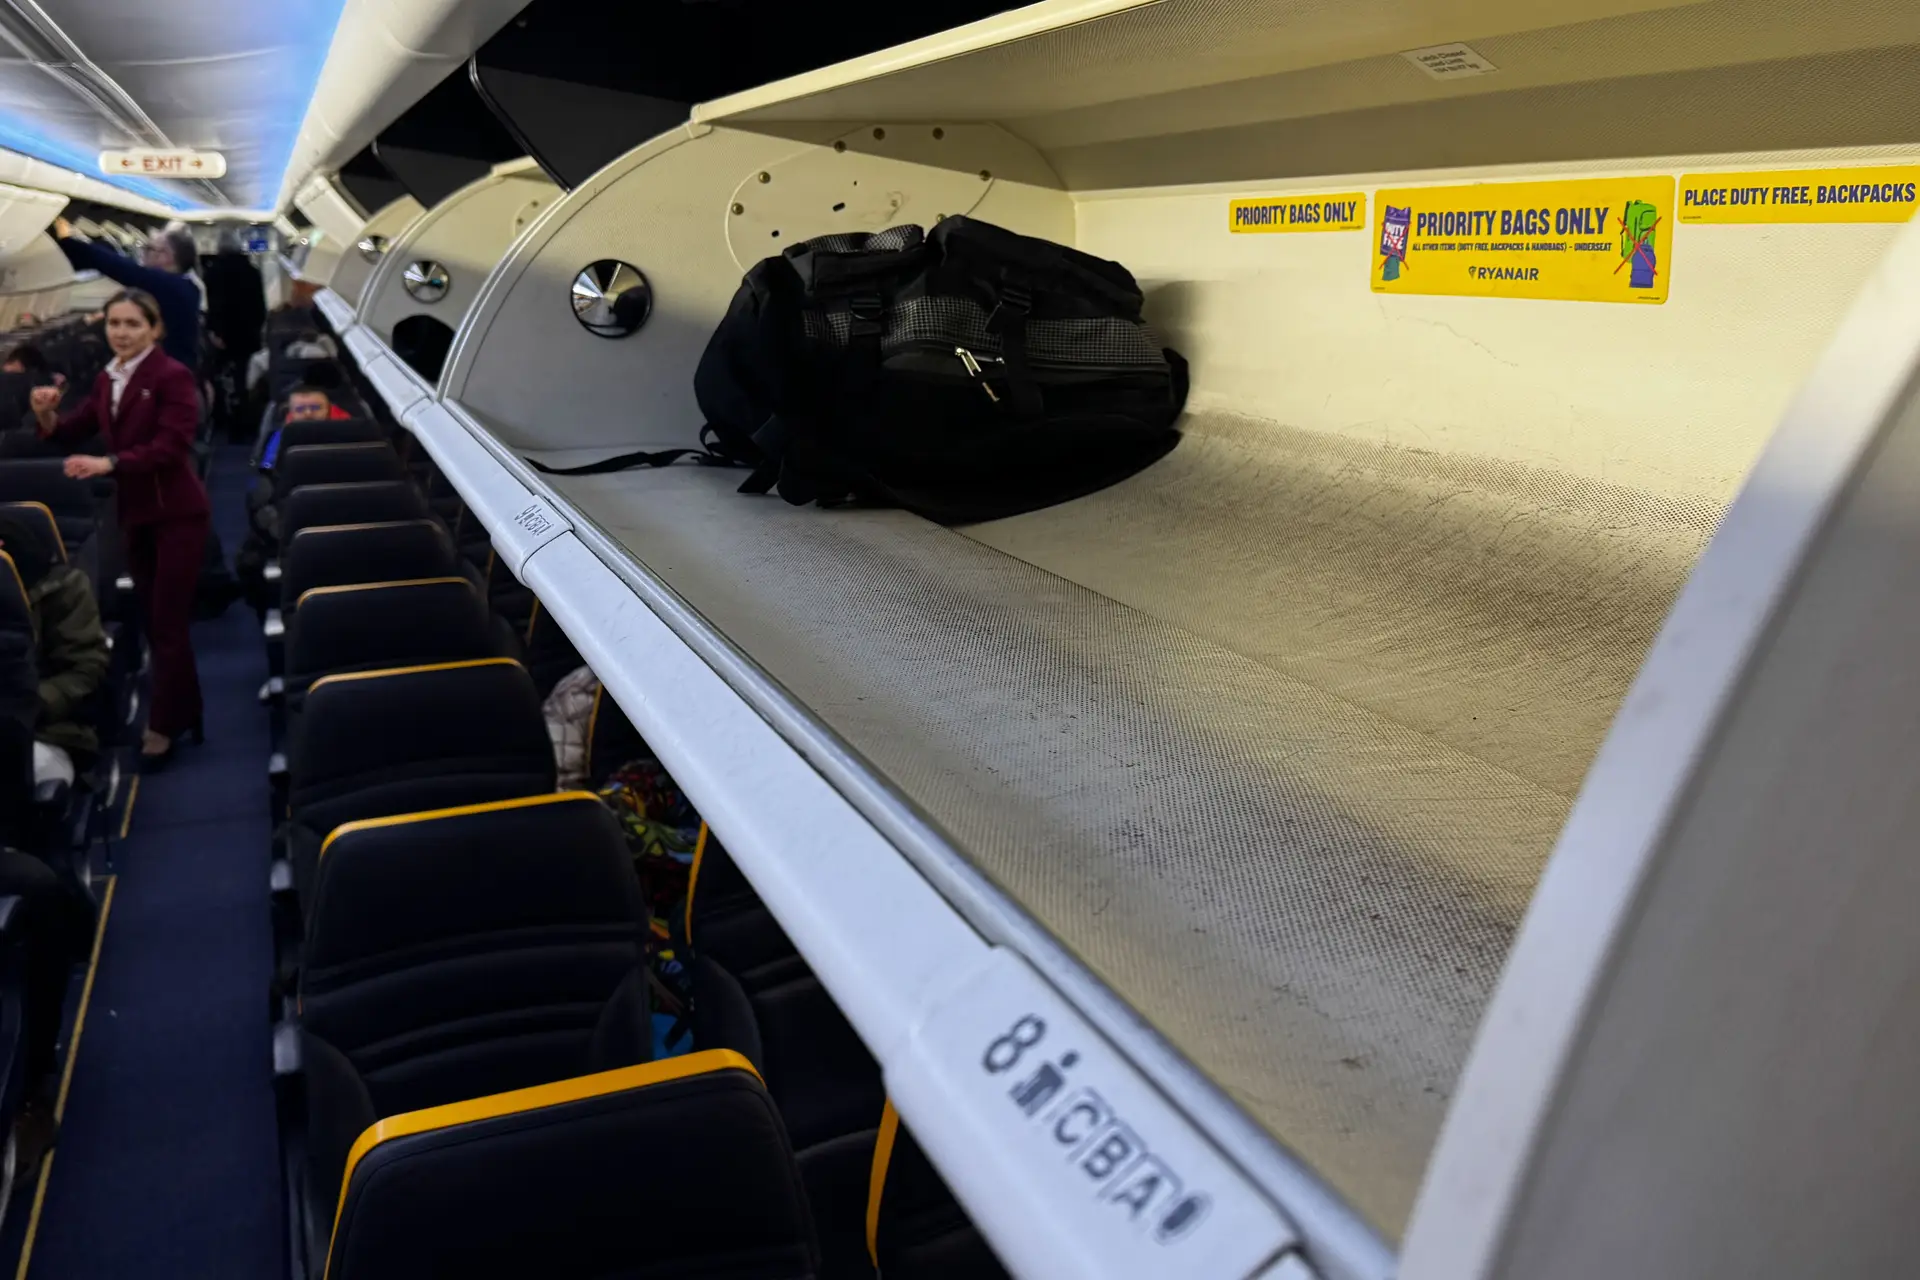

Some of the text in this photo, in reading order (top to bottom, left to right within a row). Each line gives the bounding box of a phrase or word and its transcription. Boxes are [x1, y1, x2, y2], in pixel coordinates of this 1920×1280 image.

[142, 156, 182, 172] EXIT
[1684, 182, 1916, 206] PLACE DUTY FREE, BACKPACKS
[1236, 201, 1356, 226] PRIORITY BAGS ONLY
[1416, 207, 1610, 236] PRIORITY BAGS ONLY
[1412, 243, 1421, 251] ALL
[1490, 242, 1525, 251] BACKPACKS
[1574, 242, 1613, 252] UNDERSEAT
[1478, 267, 1539, 280] RYANAIR
[982, 1013, 1047, 1074] 8
